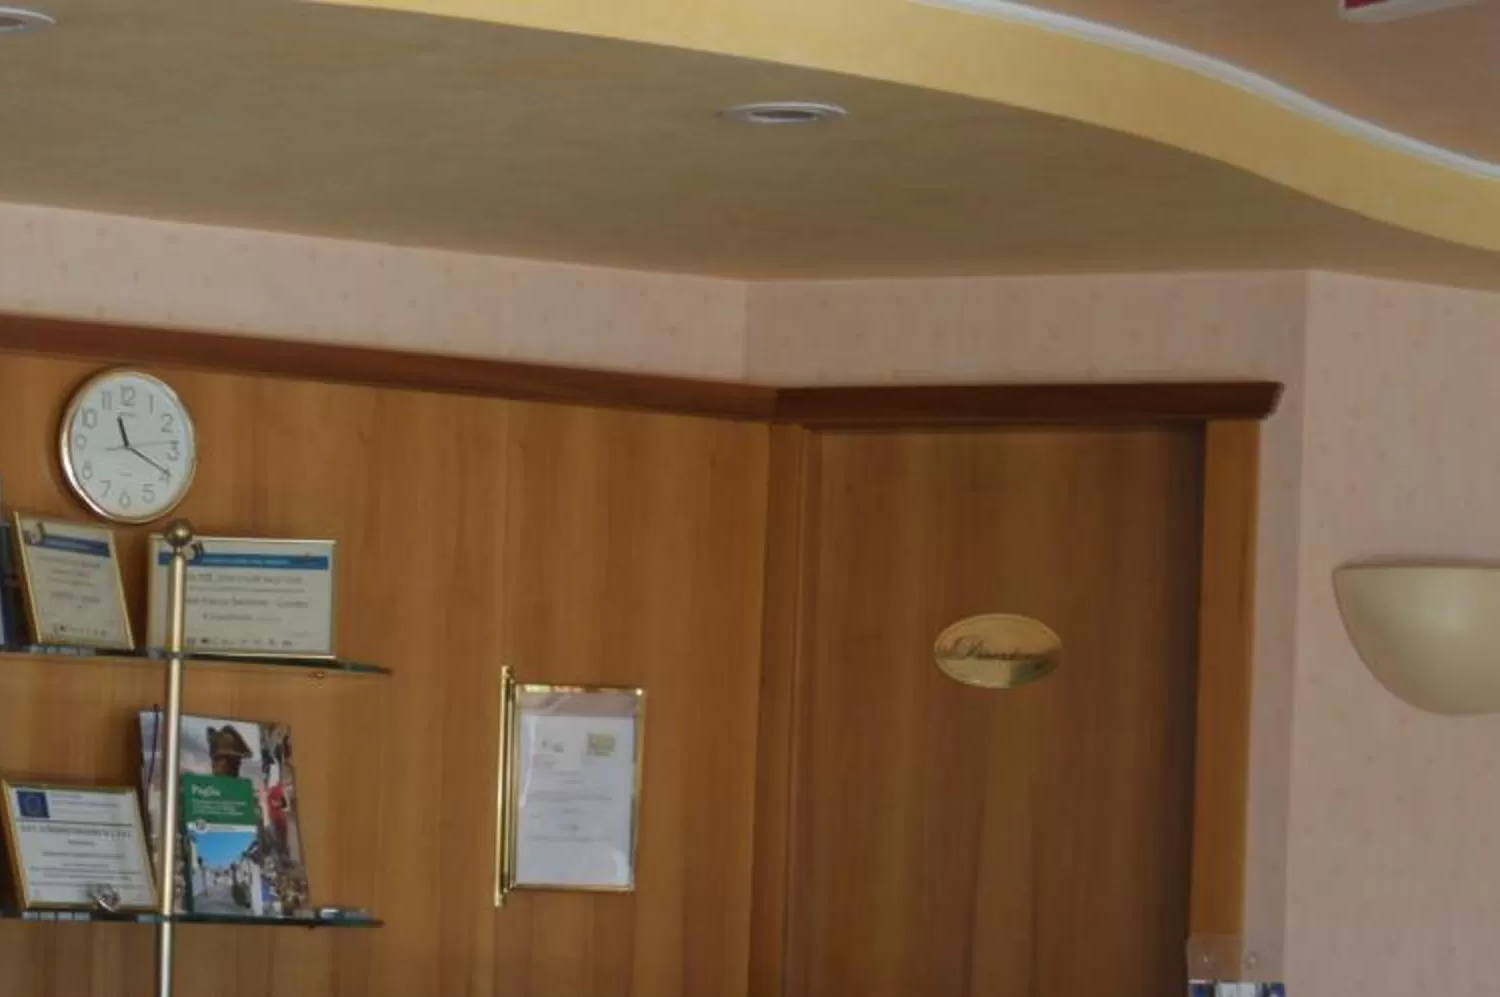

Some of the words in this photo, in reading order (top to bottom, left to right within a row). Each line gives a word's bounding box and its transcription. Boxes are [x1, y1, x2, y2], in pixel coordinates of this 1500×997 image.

[102, 390, 113, 411] 11
[120, 385, 137, 407] 12
[81, 407, 98, 429] 10
[161, 412, 173, 433] 2
[167, 440, 180, 462] 3
[81, 460, 93, 480] 8
[100, 480, 111, 499] 7
[118, 488, 131, 508] 6
[142, 483, 156, 504] 5
